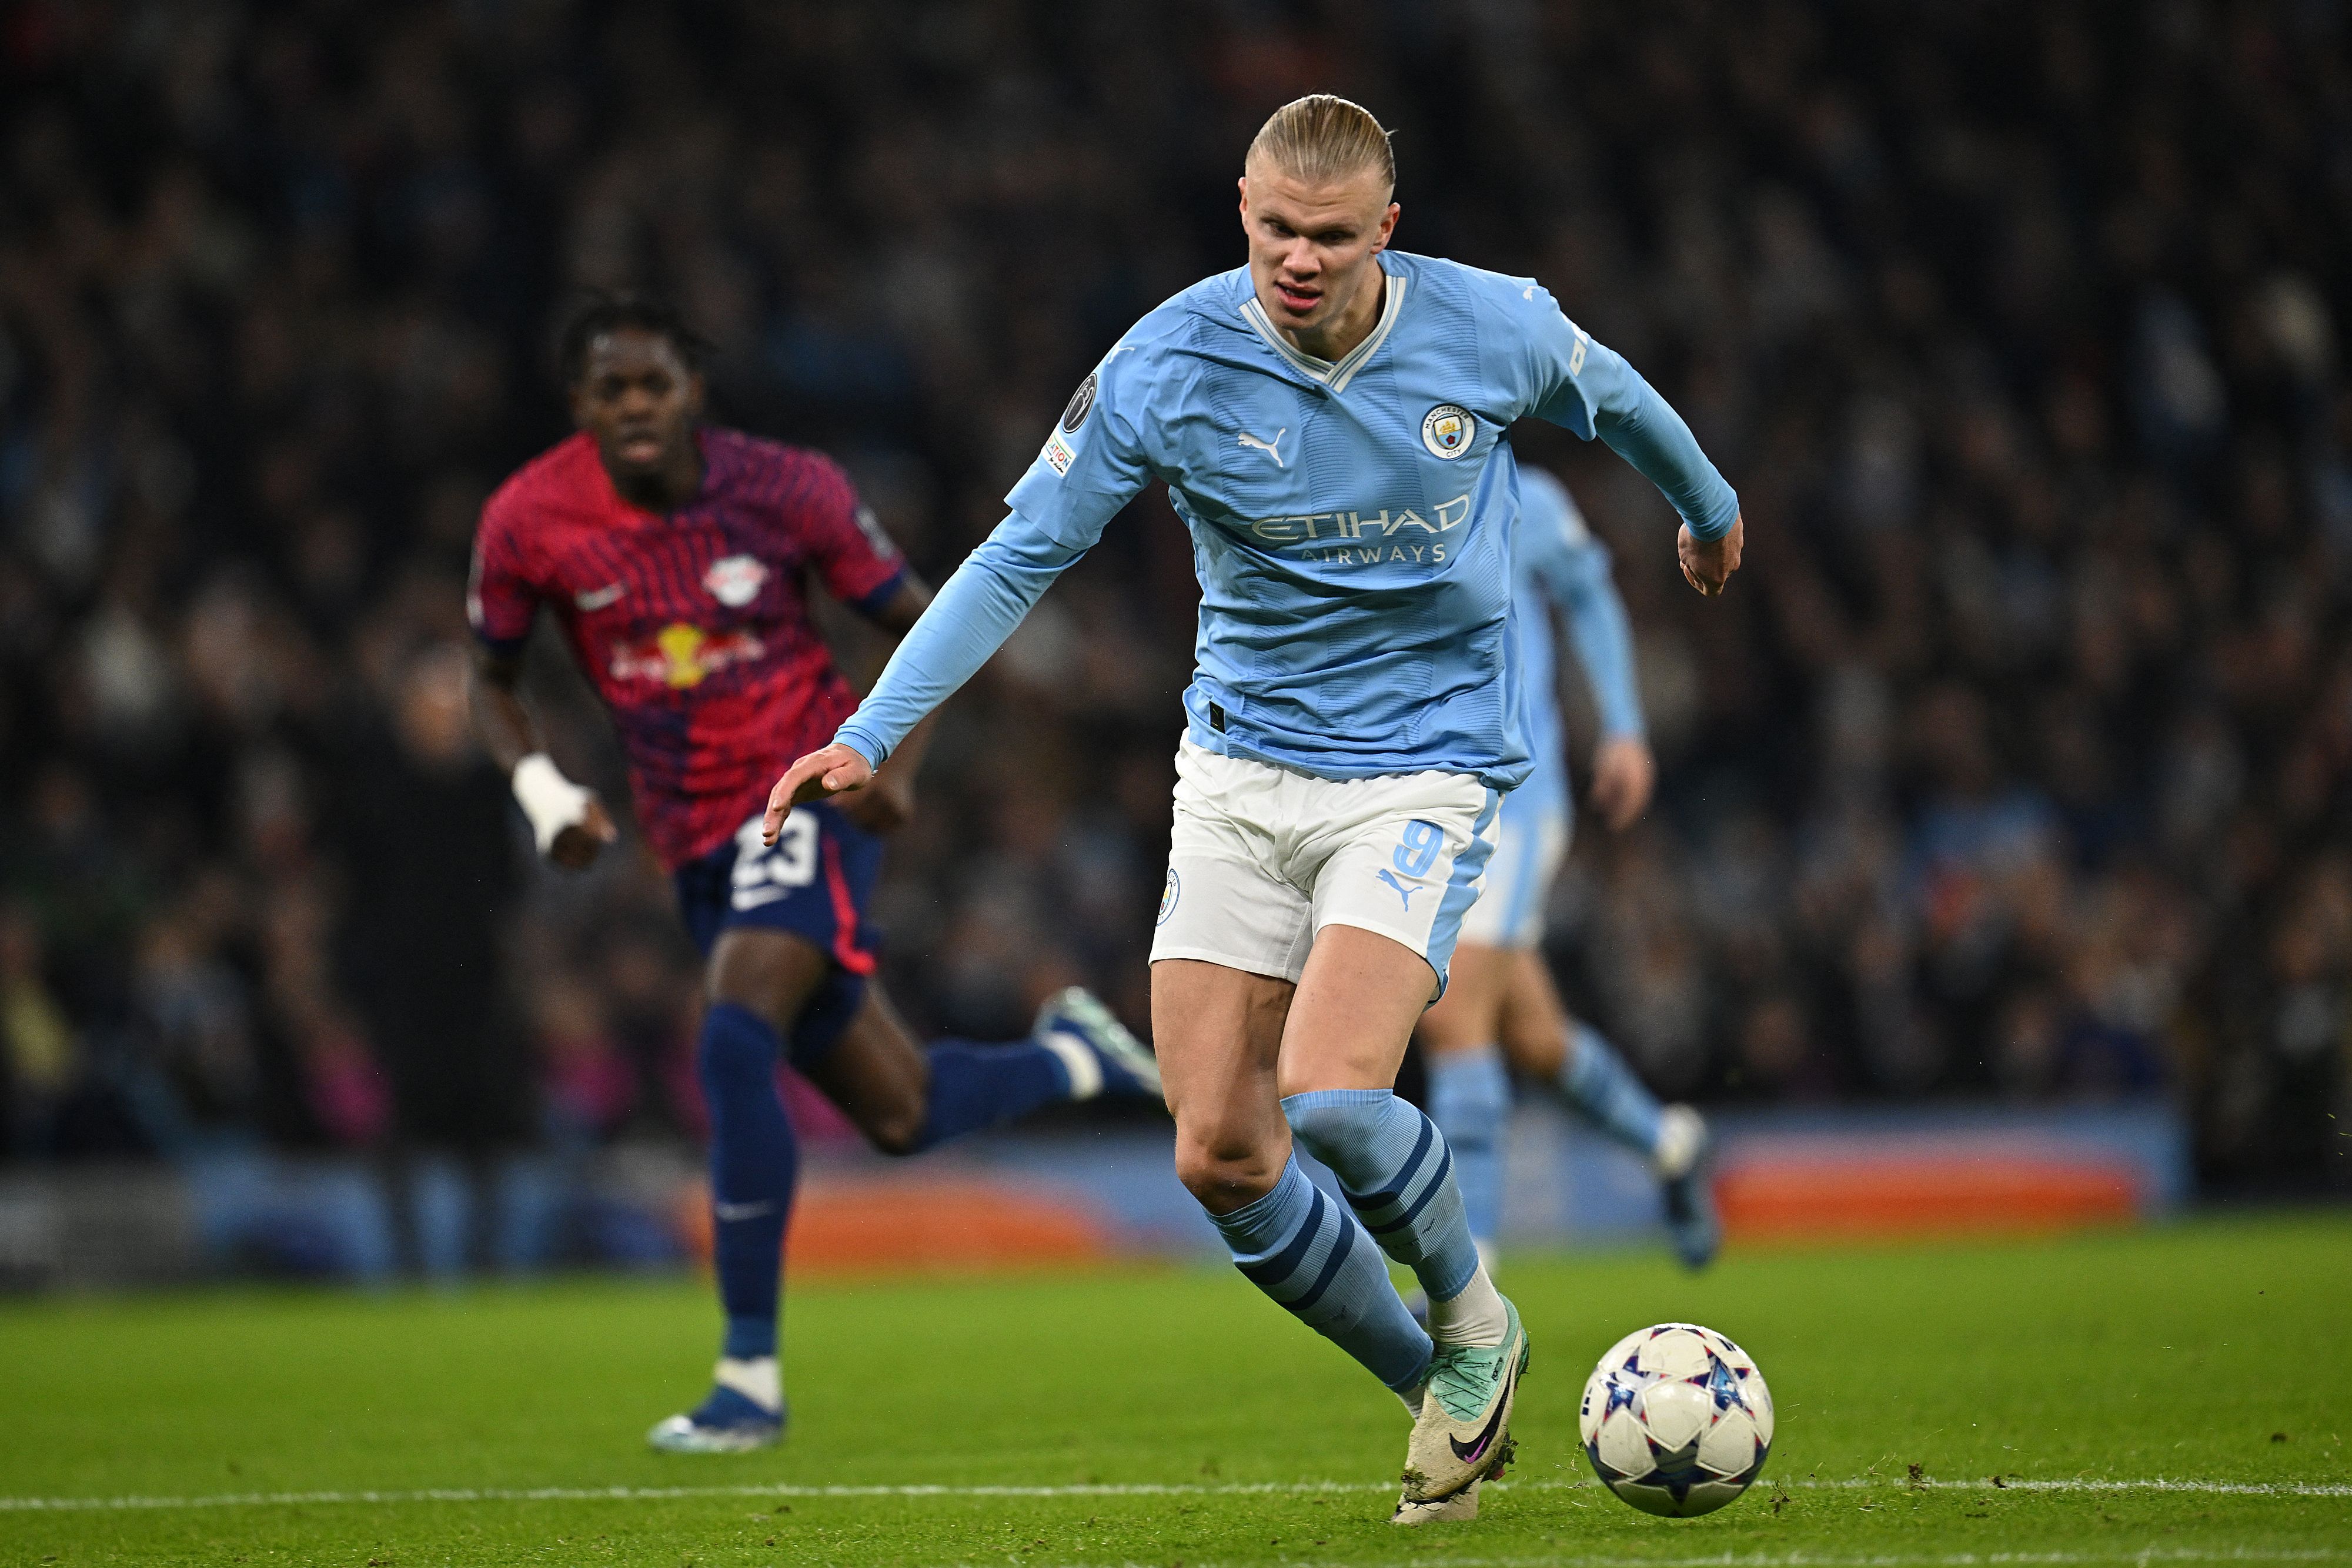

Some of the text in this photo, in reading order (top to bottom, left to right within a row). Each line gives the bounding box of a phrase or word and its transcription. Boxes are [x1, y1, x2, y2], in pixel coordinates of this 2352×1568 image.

[1425, 407, 1469, 429] MANCHESTER
[1446, 449, 1461, 457] CITY
[1251, 494, 1470, 540] ETIHAD
[1301, 543, 1446, 564] AIRWAYS
[731, 807, 819, 887] 23
[1392, 818, 1444, 878] 9
